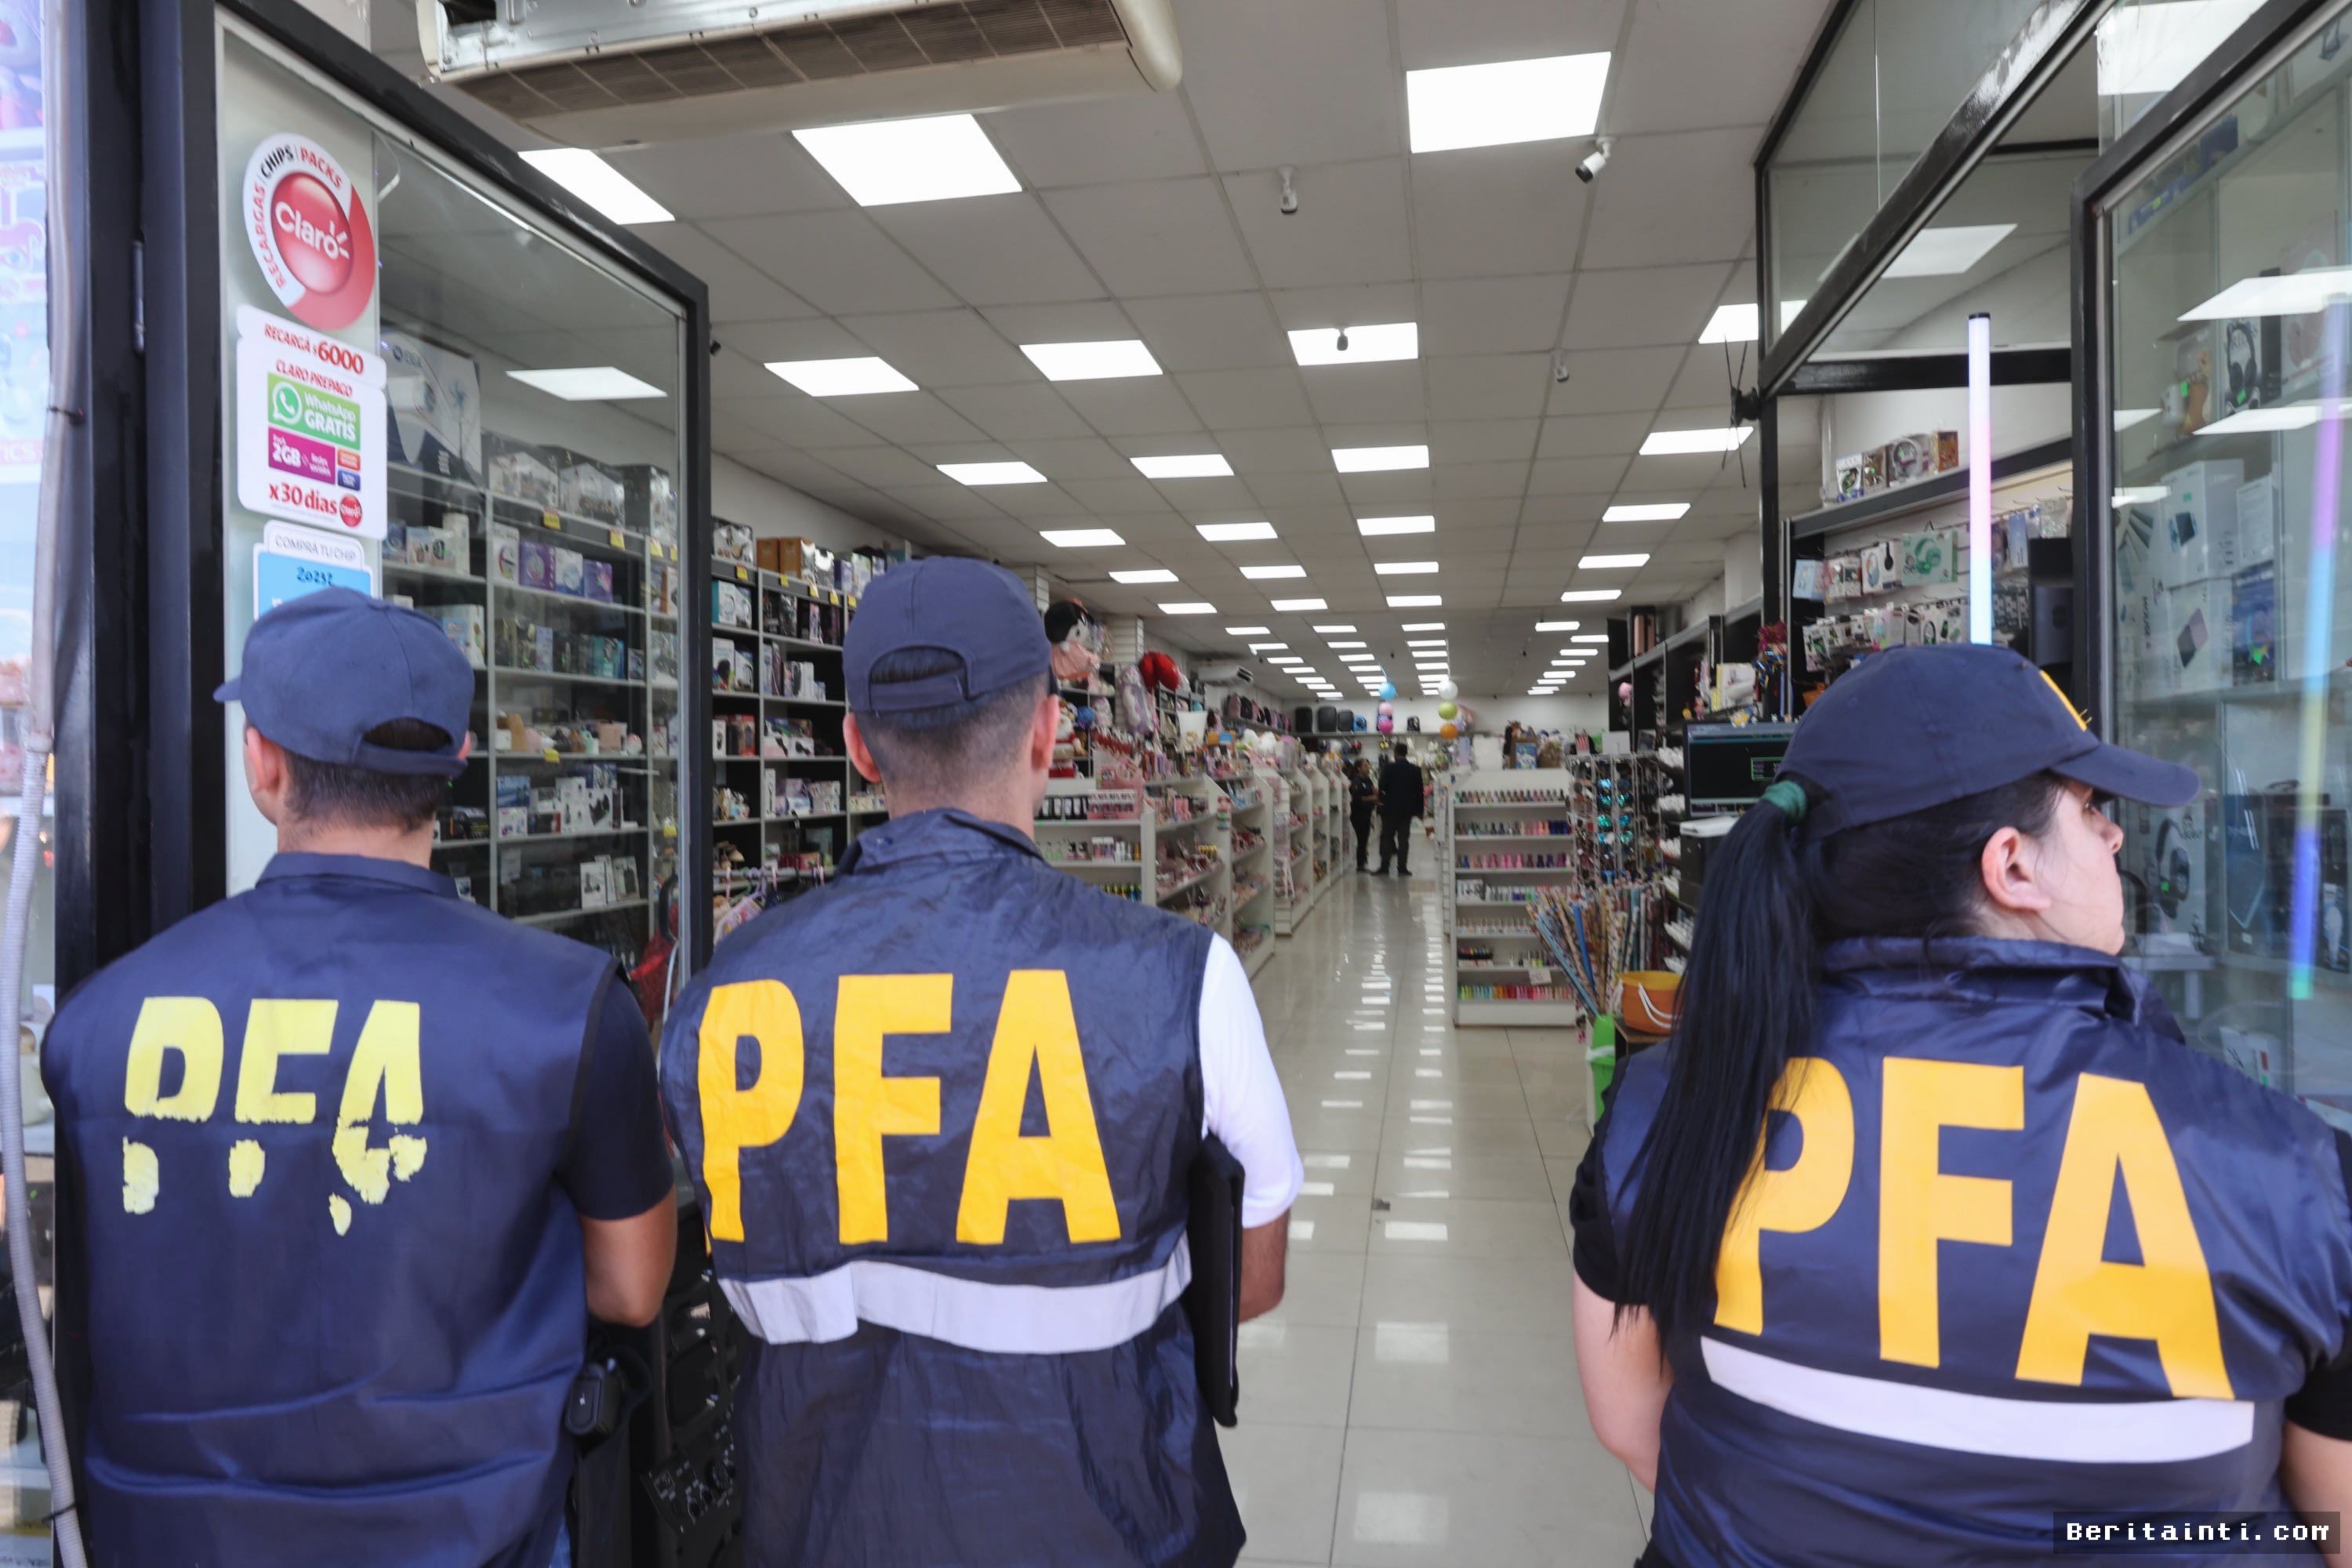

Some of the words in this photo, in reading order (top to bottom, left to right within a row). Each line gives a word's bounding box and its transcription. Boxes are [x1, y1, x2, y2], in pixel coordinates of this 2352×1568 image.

[260, 144, 293, 179] CHIPS
[300, 147, 342, 188] PACKS
[252, 183, 285, 287] RECARGAS
[275, 201, 339, 260] Claro
[276, 359, 309, 382] CLARO
[310, 371, 353, 397] PREPAGO
[304, 393, 355, 423] WhatsApp
[272, 443, 302, 468] 2GB
[698, 969, 1122, 1245] PFA
[1713, 1056, 2235, 1400] PFA
